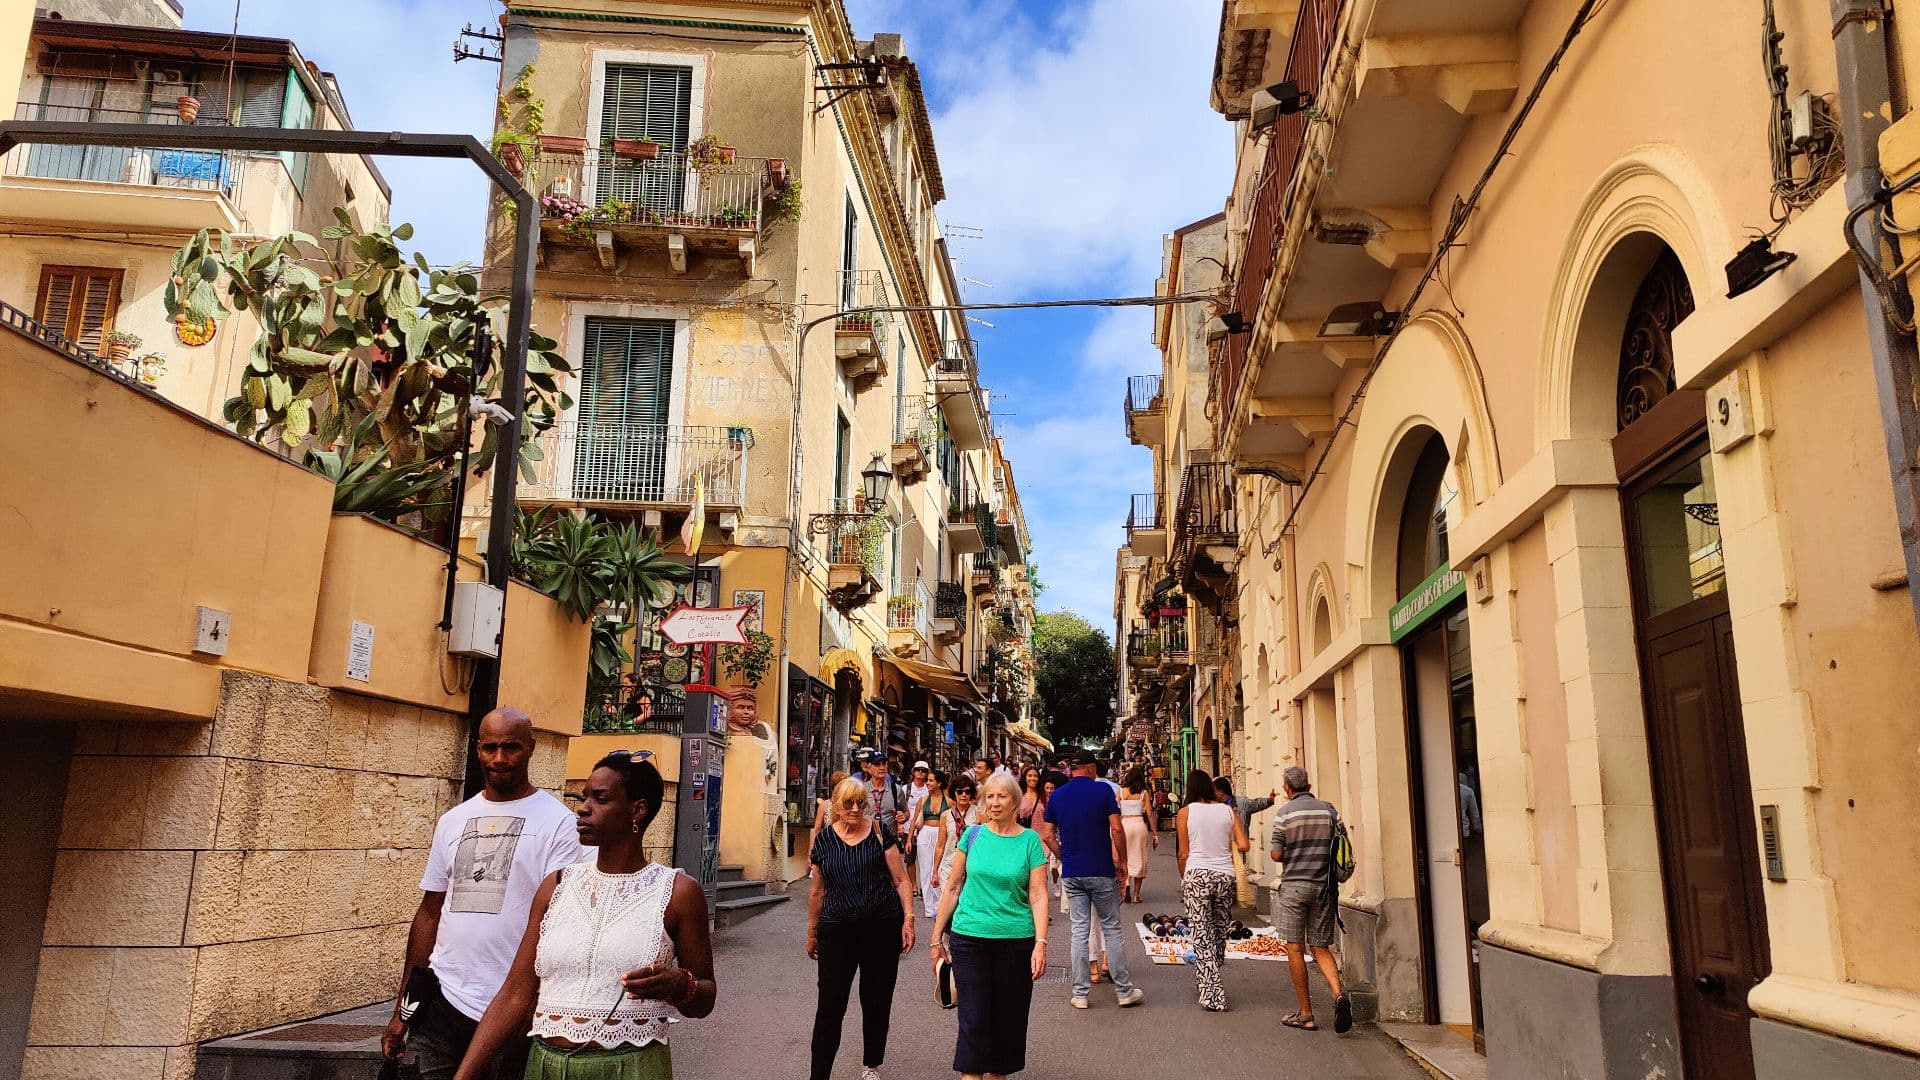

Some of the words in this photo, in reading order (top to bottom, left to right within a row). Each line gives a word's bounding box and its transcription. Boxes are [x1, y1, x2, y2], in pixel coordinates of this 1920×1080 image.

[1718, 397, 1729, 426] 9
[1476, 570, 1483, 590] 11
[1392, 604, 1411, 631] UNITED
[1411, 585, 1434, 617] COLORS
[1434, 577, 1442, 600] OF
[210, 621, 219, 640] 4
